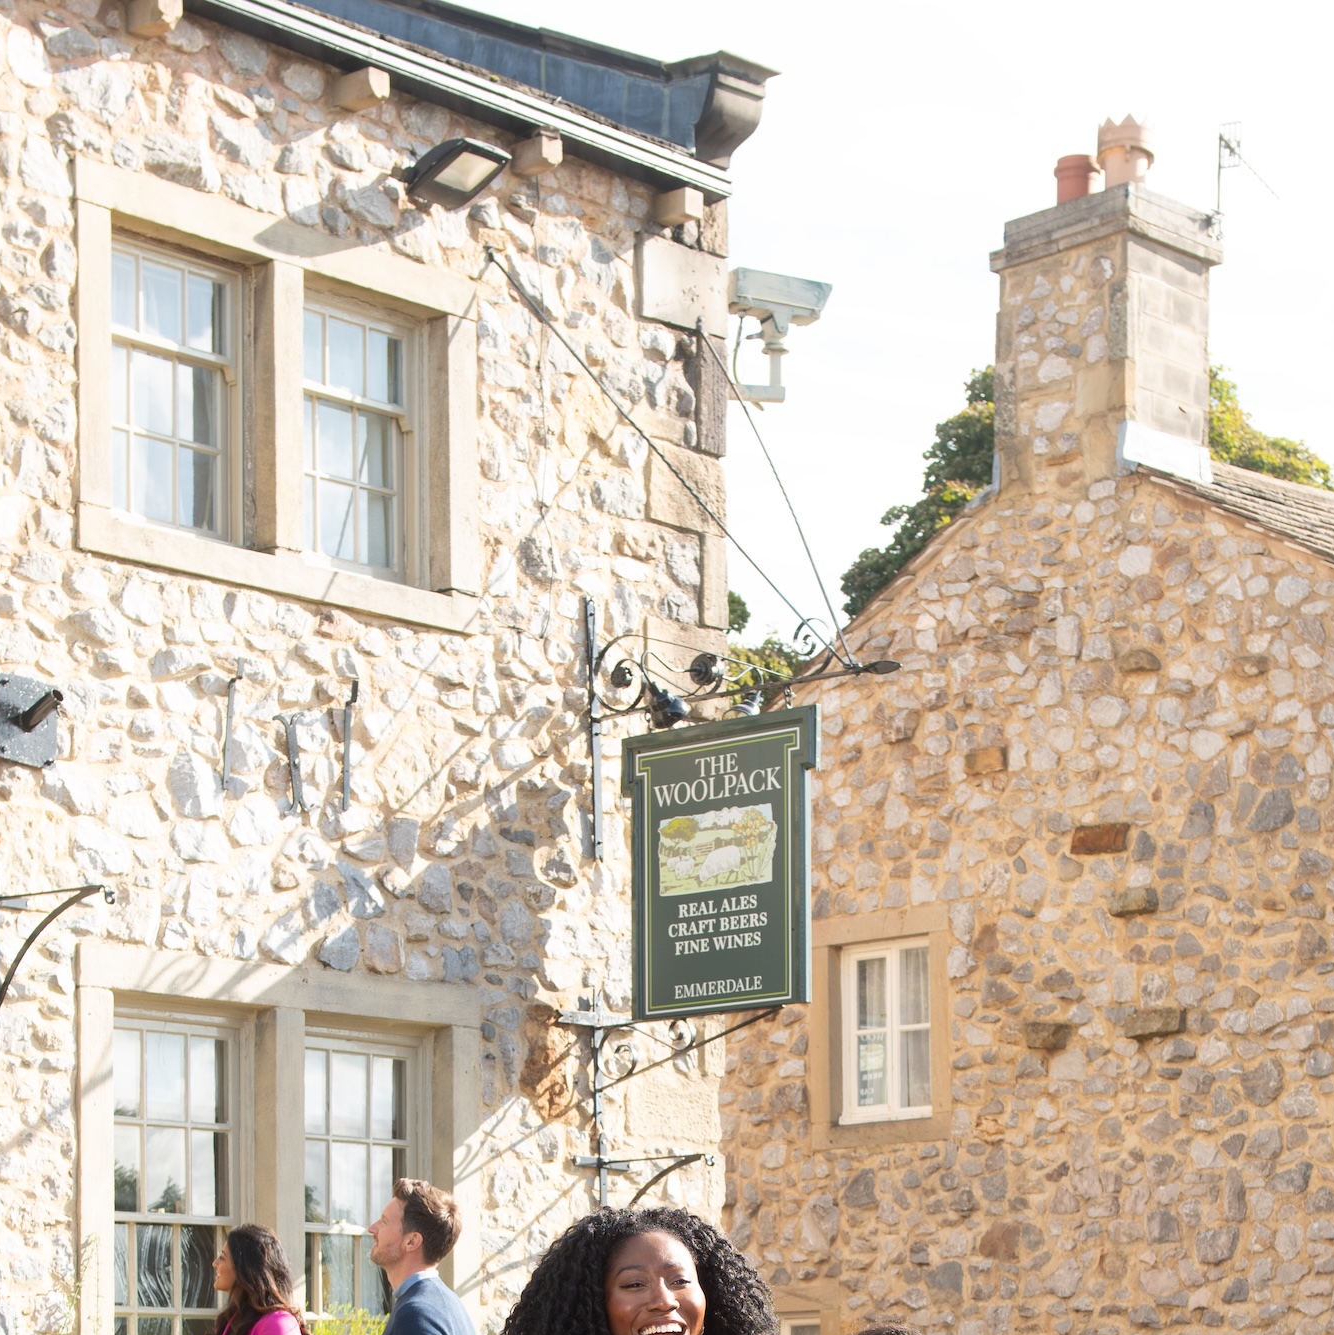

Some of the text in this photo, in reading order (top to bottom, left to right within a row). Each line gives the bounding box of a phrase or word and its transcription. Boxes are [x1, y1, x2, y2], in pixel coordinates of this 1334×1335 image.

[695, 753, 738, 777] THE
[653, 766, 782, 808] WOOLPACK
[678, 895, 757, 918] REAL ALES
[668, 912, 767, 937] CRAFT BEERS
[675, 932, 761, 955] FINE WINES
[675, 976, 762, 999] EMMERDALE
